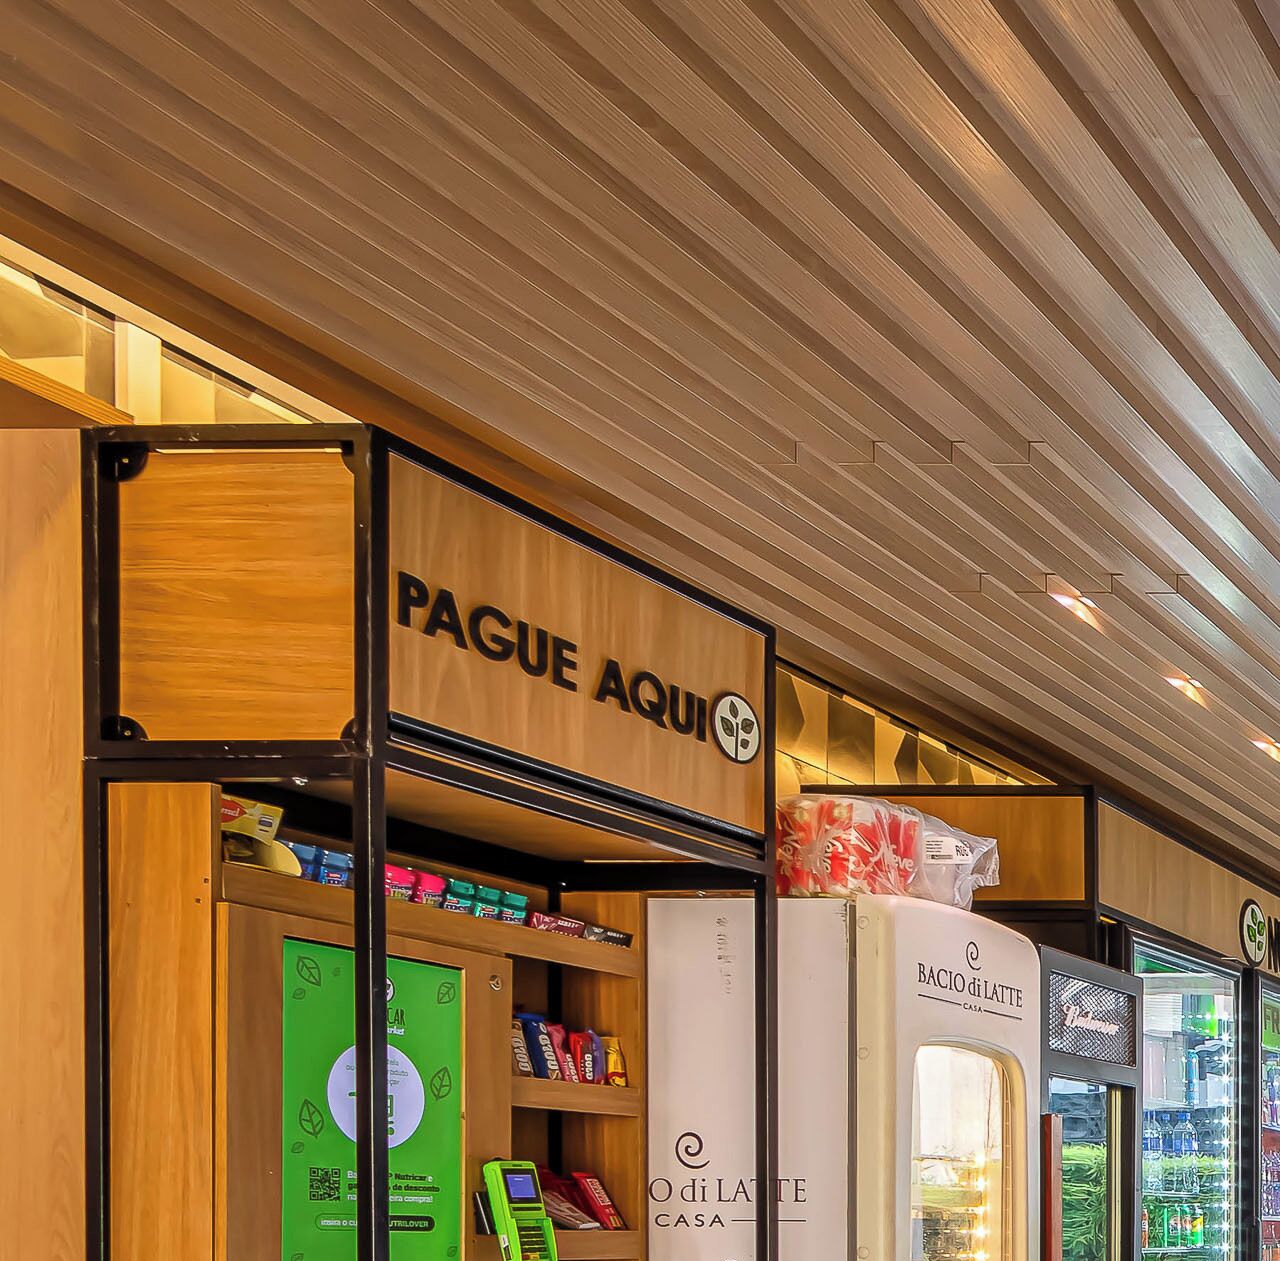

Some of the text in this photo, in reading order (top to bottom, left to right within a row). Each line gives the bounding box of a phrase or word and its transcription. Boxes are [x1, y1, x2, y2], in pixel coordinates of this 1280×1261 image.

[396, 571, 707, 744] PAGUE AQUI
[917, 963, 1023, 1008] BACIO di LATTE
[963, 1002, 983, 1014] CASA
[680, 1178, 708, 1203] di
[388, 1218, 429, 1228] UTRILOVER
[655, 1213, 726, 1228] CASA
